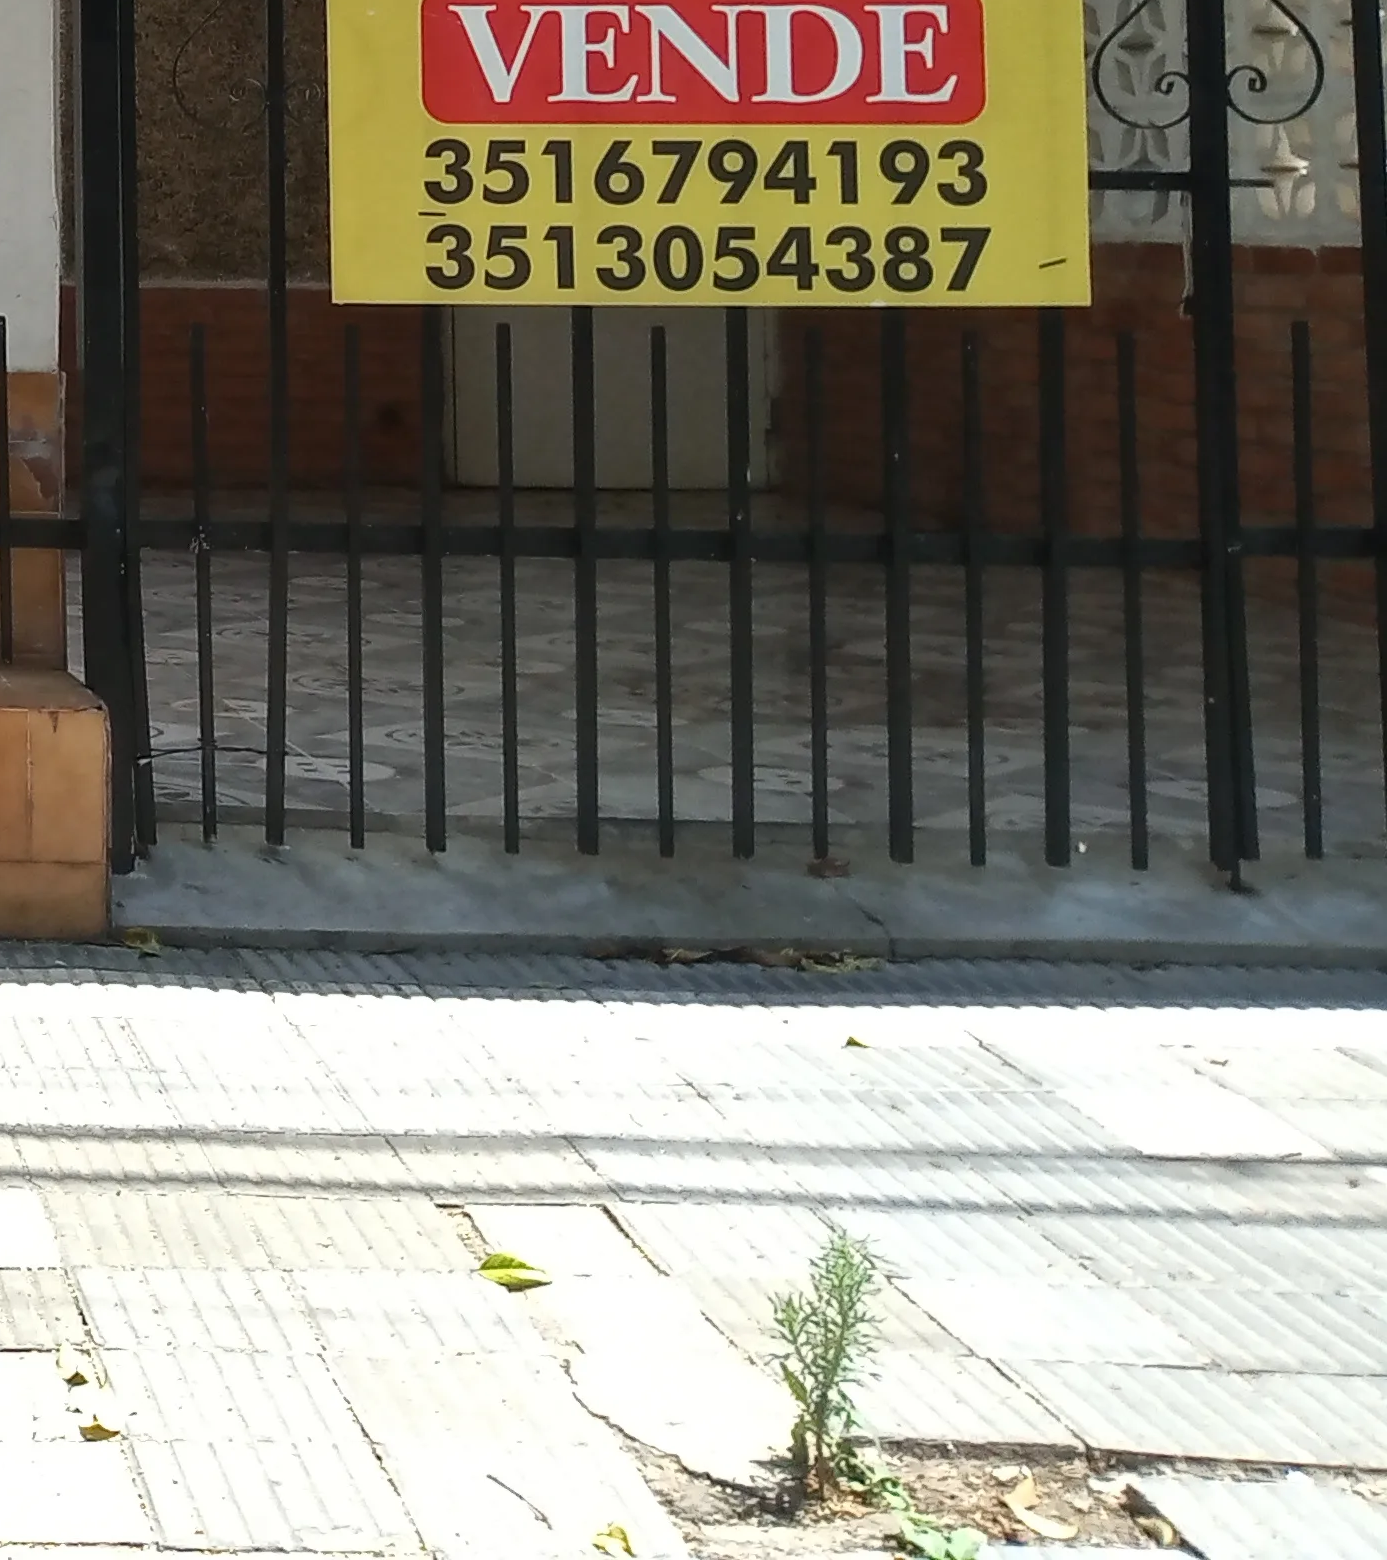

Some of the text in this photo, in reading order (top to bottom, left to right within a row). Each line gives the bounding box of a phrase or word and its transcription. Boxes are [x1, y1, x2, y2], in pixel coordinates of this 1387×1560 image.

[447, 2, 959, 105] VENDE
[424, 138, 988, 206] 3516794193
[425, 225, 992, 292] 3513054387
